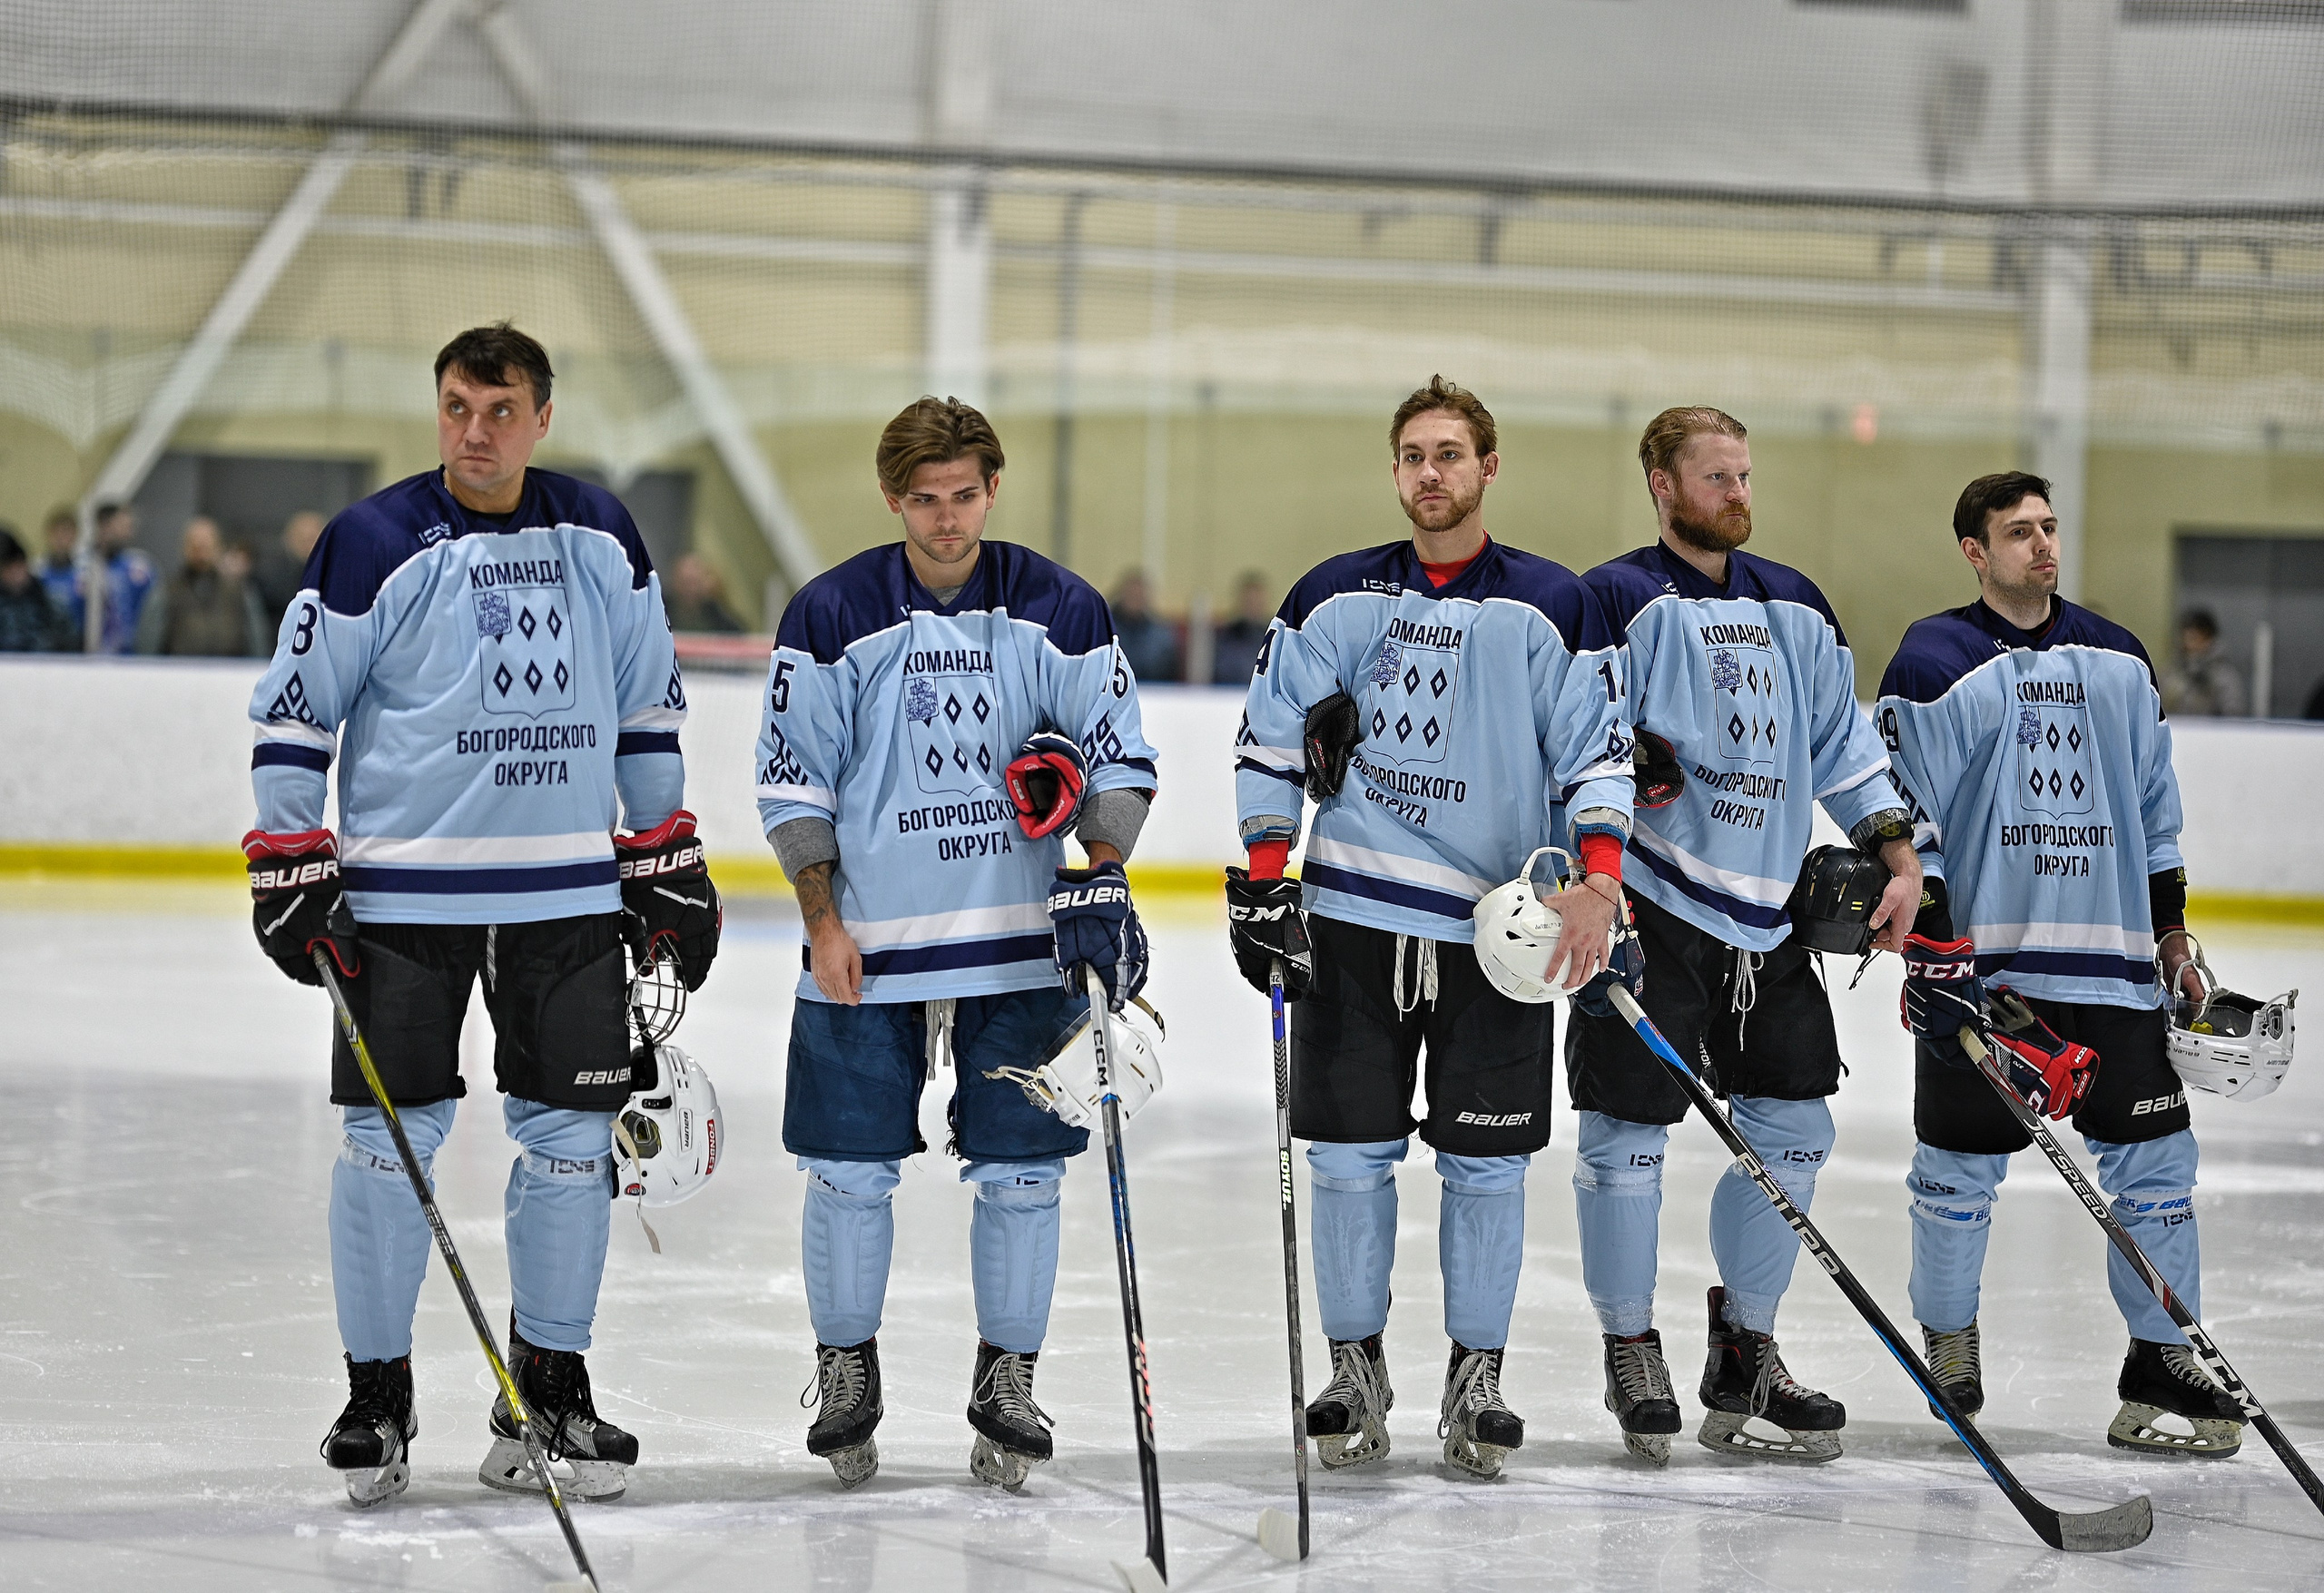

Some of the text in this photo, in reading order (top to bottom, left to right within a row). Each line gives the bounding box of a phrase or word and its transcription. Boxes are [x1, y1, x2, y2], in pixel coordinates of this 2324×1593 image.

[468, 559, 565, 589] КОМАНДА
[290, 601, 318, 656] 8
[1384, 617, 1463, 650] ОМАНДА
[1699, 624, 1773, 649] КОМАНДА
[902, 648, 994, 676] КОМАНДА
[1101, 647, 1129, 699] 5
[1597, 659, 1627, 703] 1
[457, 723, 596, 755] БОГОРОДСКОГО
[494, 761, 568, 787] ОКРУГА
[898, 799, 1019, 834] БОГОРОДСКО
[1710, 799, 1766, 831] ОКРУГА
[618, 844, 704, 879] BAUER
[938, 831, 1012, 861] ОКРУГА
[248, 860, 340, 889] BAUER
[2034, 853, 2090, 877] ОКРУГА
[1047, 886, 1127, 914] BAUER
[1229, 903, 1287, 922] CM
[1907, 959, 1975, 979] CCM
[1094, 1029, 1108, 1087] CCM
[2131, 1090, 2187, 1116] BAUE
[1454, 1111, 1532, 1127] BAUER
[1280, 1150, 1292, 1204] SOYUZ
[2023, 1117, 2108, 1220] JETSPEED
[2271, 1441, 2316, 1495] JETSPEED
